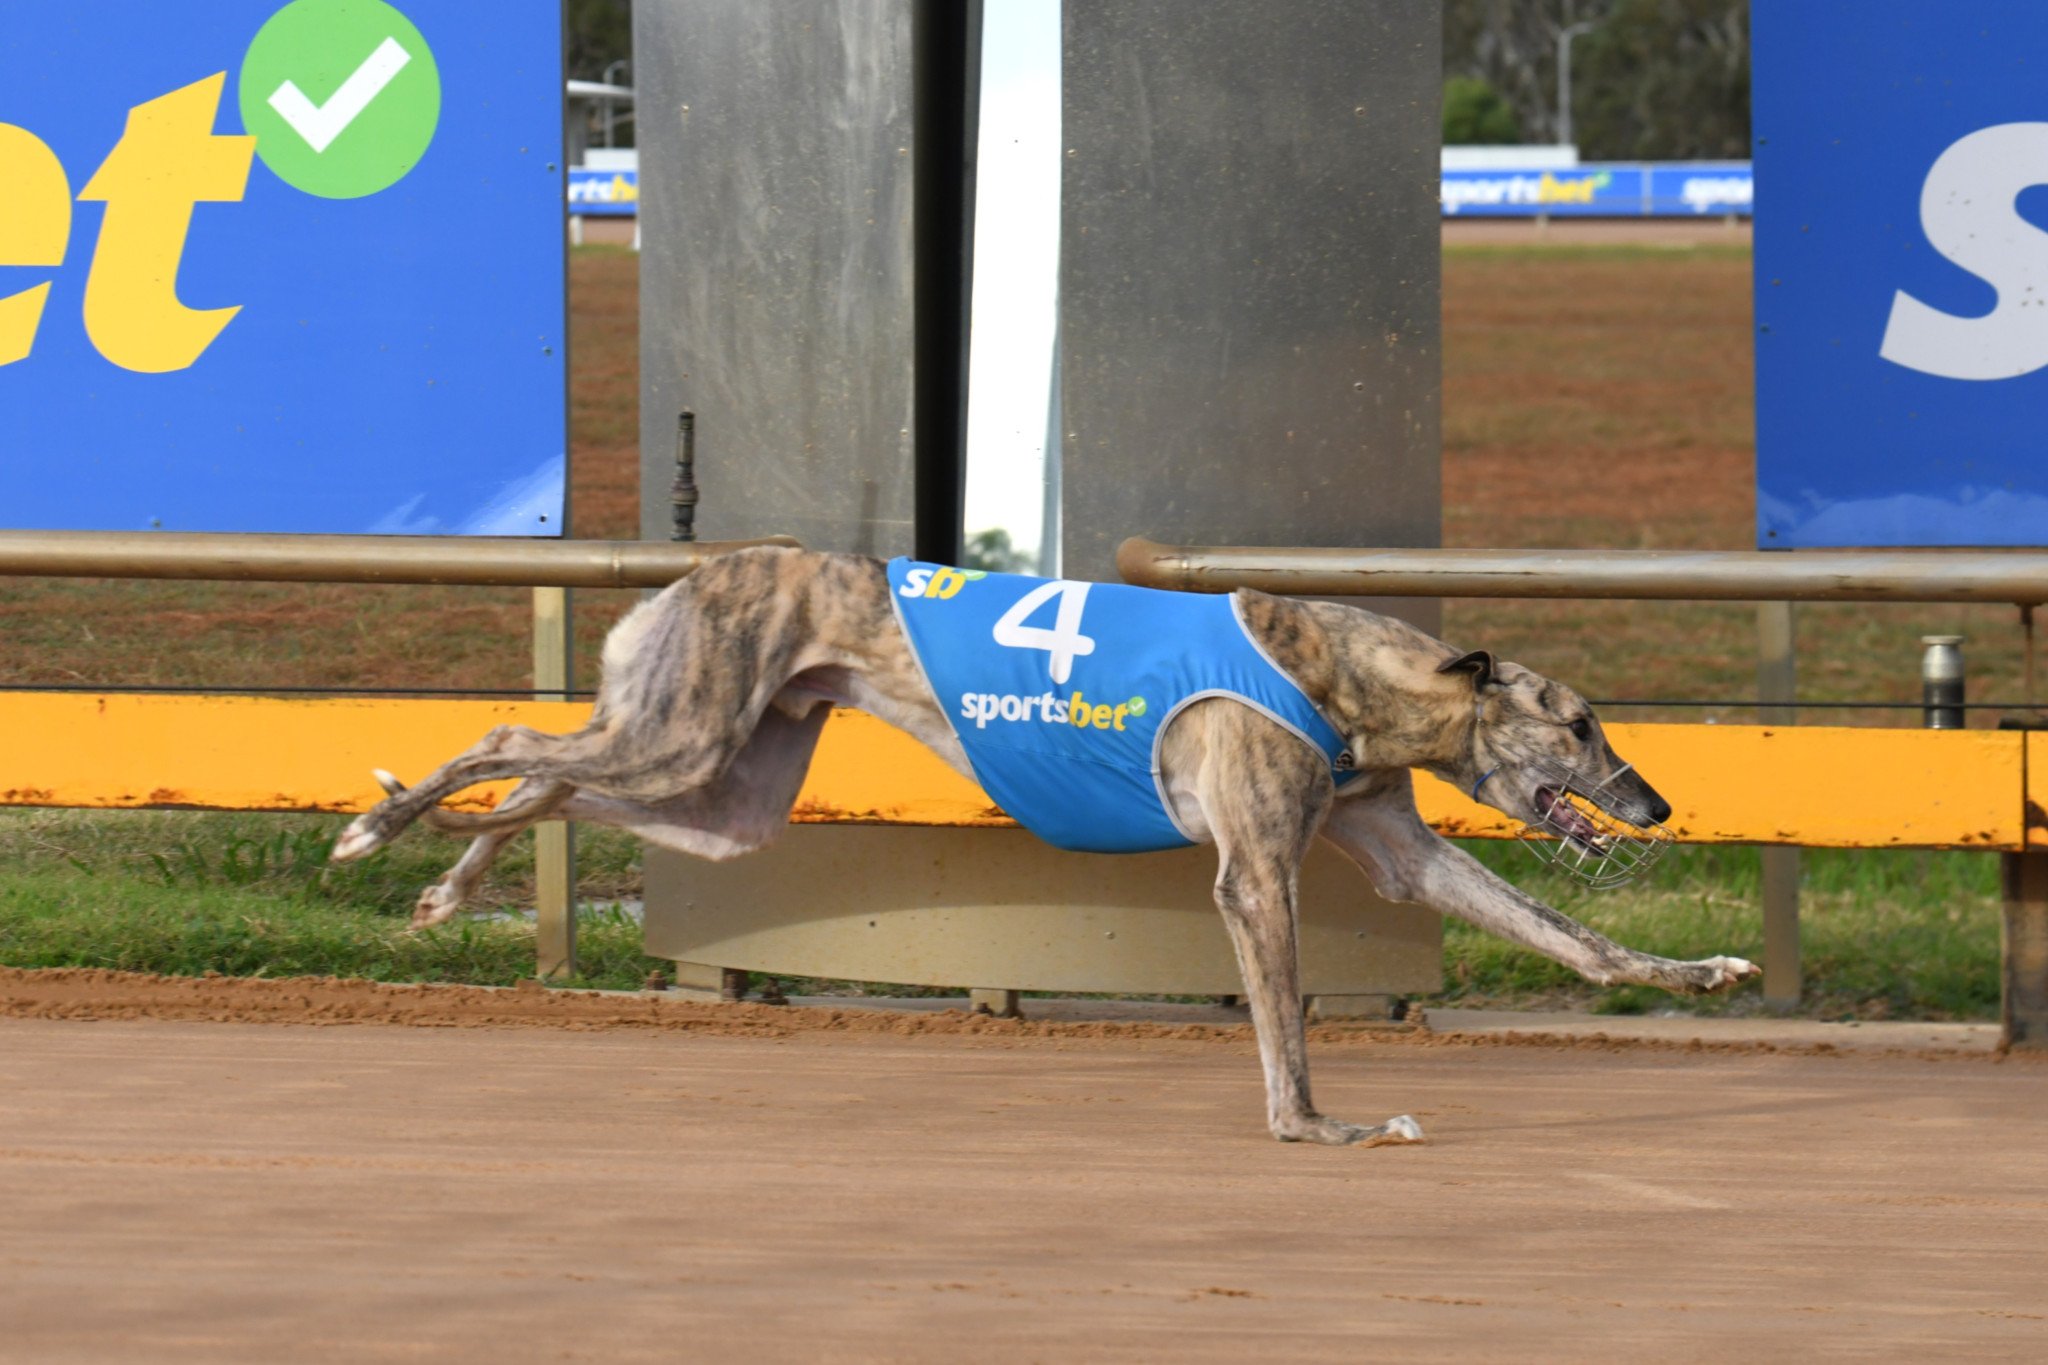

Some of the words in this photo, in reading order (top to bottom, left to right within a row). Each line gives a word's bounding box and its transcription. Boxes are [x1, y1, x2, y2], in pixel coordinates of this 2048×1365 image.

[899, 566, 966, 600] sb
[993, 579, 1096, 685] 4
[961, 691, 1130, 731] sportsbet
